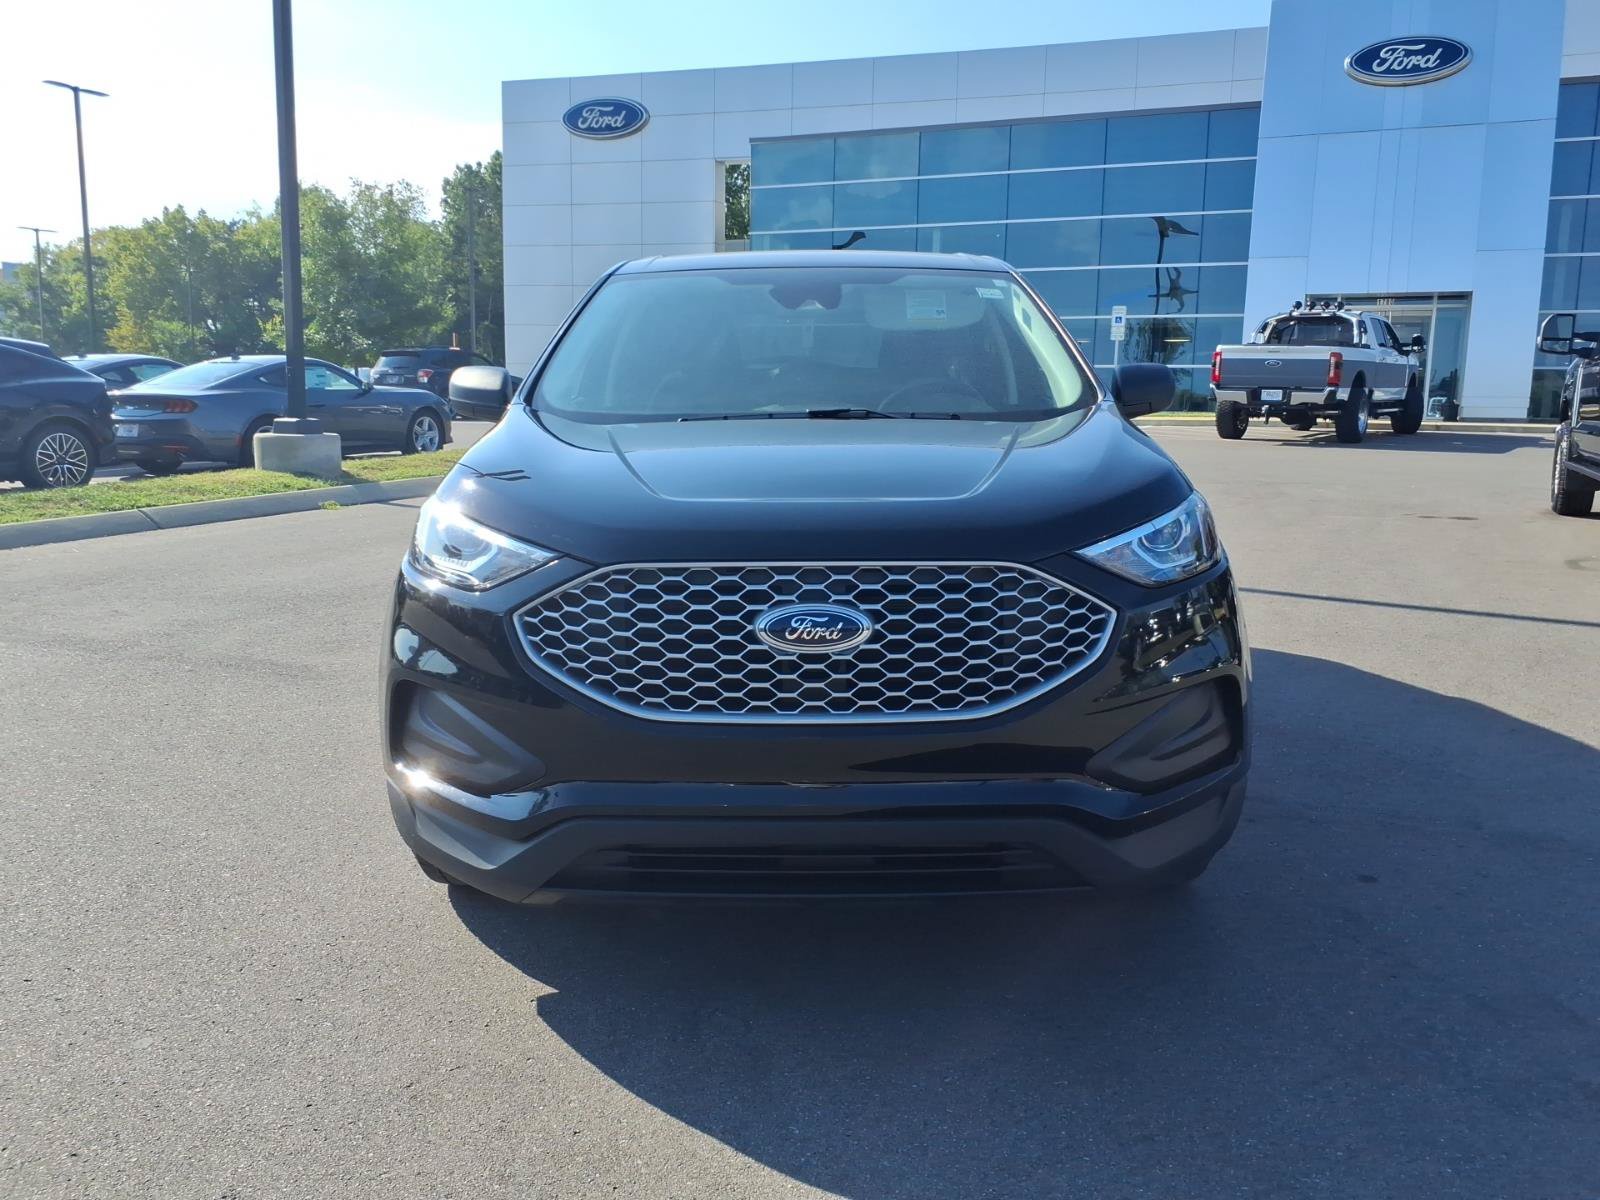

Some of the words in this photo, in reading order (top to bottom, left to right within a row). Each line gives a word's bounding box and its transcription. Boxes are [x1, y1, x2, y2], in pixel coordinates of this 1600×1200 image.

[1372, 44, 1443, 72] Ford
[578, 106, 626, 129] Ford
[785, 616, 843, 640] Ford
